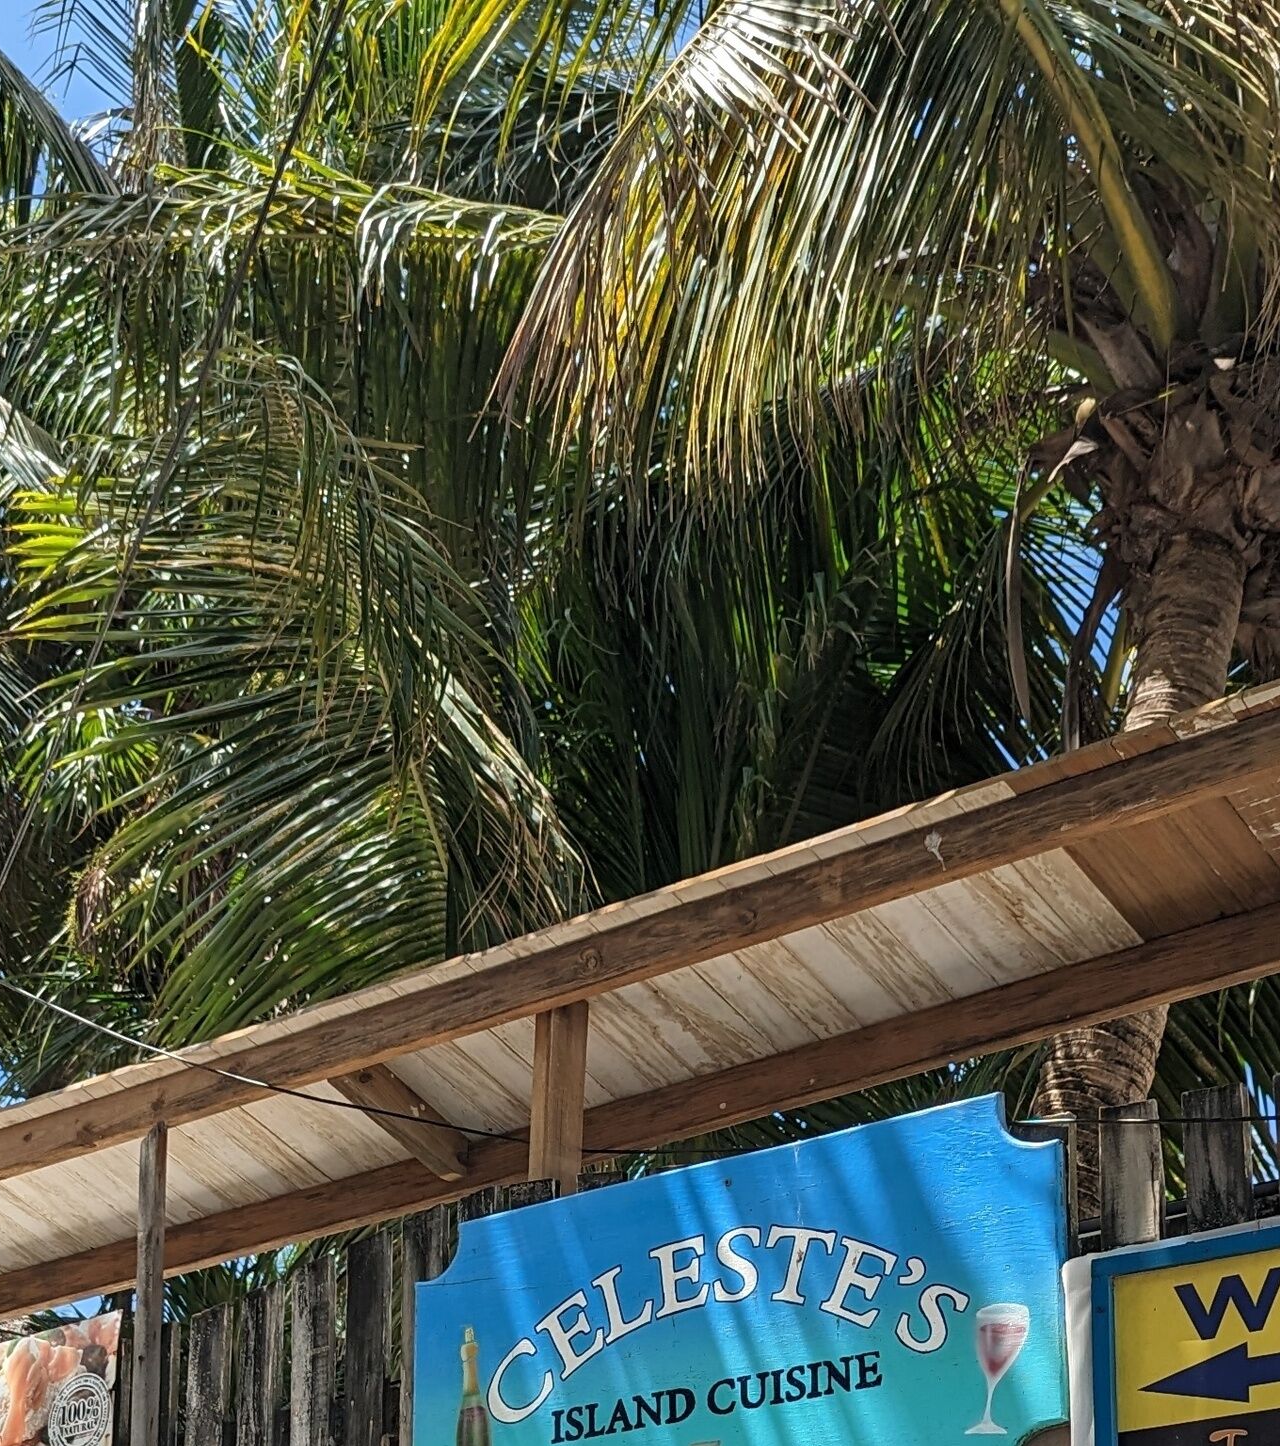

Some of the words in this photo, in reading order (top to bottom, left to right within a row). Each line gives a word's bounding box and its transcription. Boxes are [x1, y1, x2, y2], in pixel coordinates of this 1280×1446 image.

[487, 1224, 971, 1426] CELESTE'S
[60, 1396, 100, 1426] 100%
[551, 1388, 696, 1445] ISLAND
[707, 1351, 884, 1416] CUISINE
